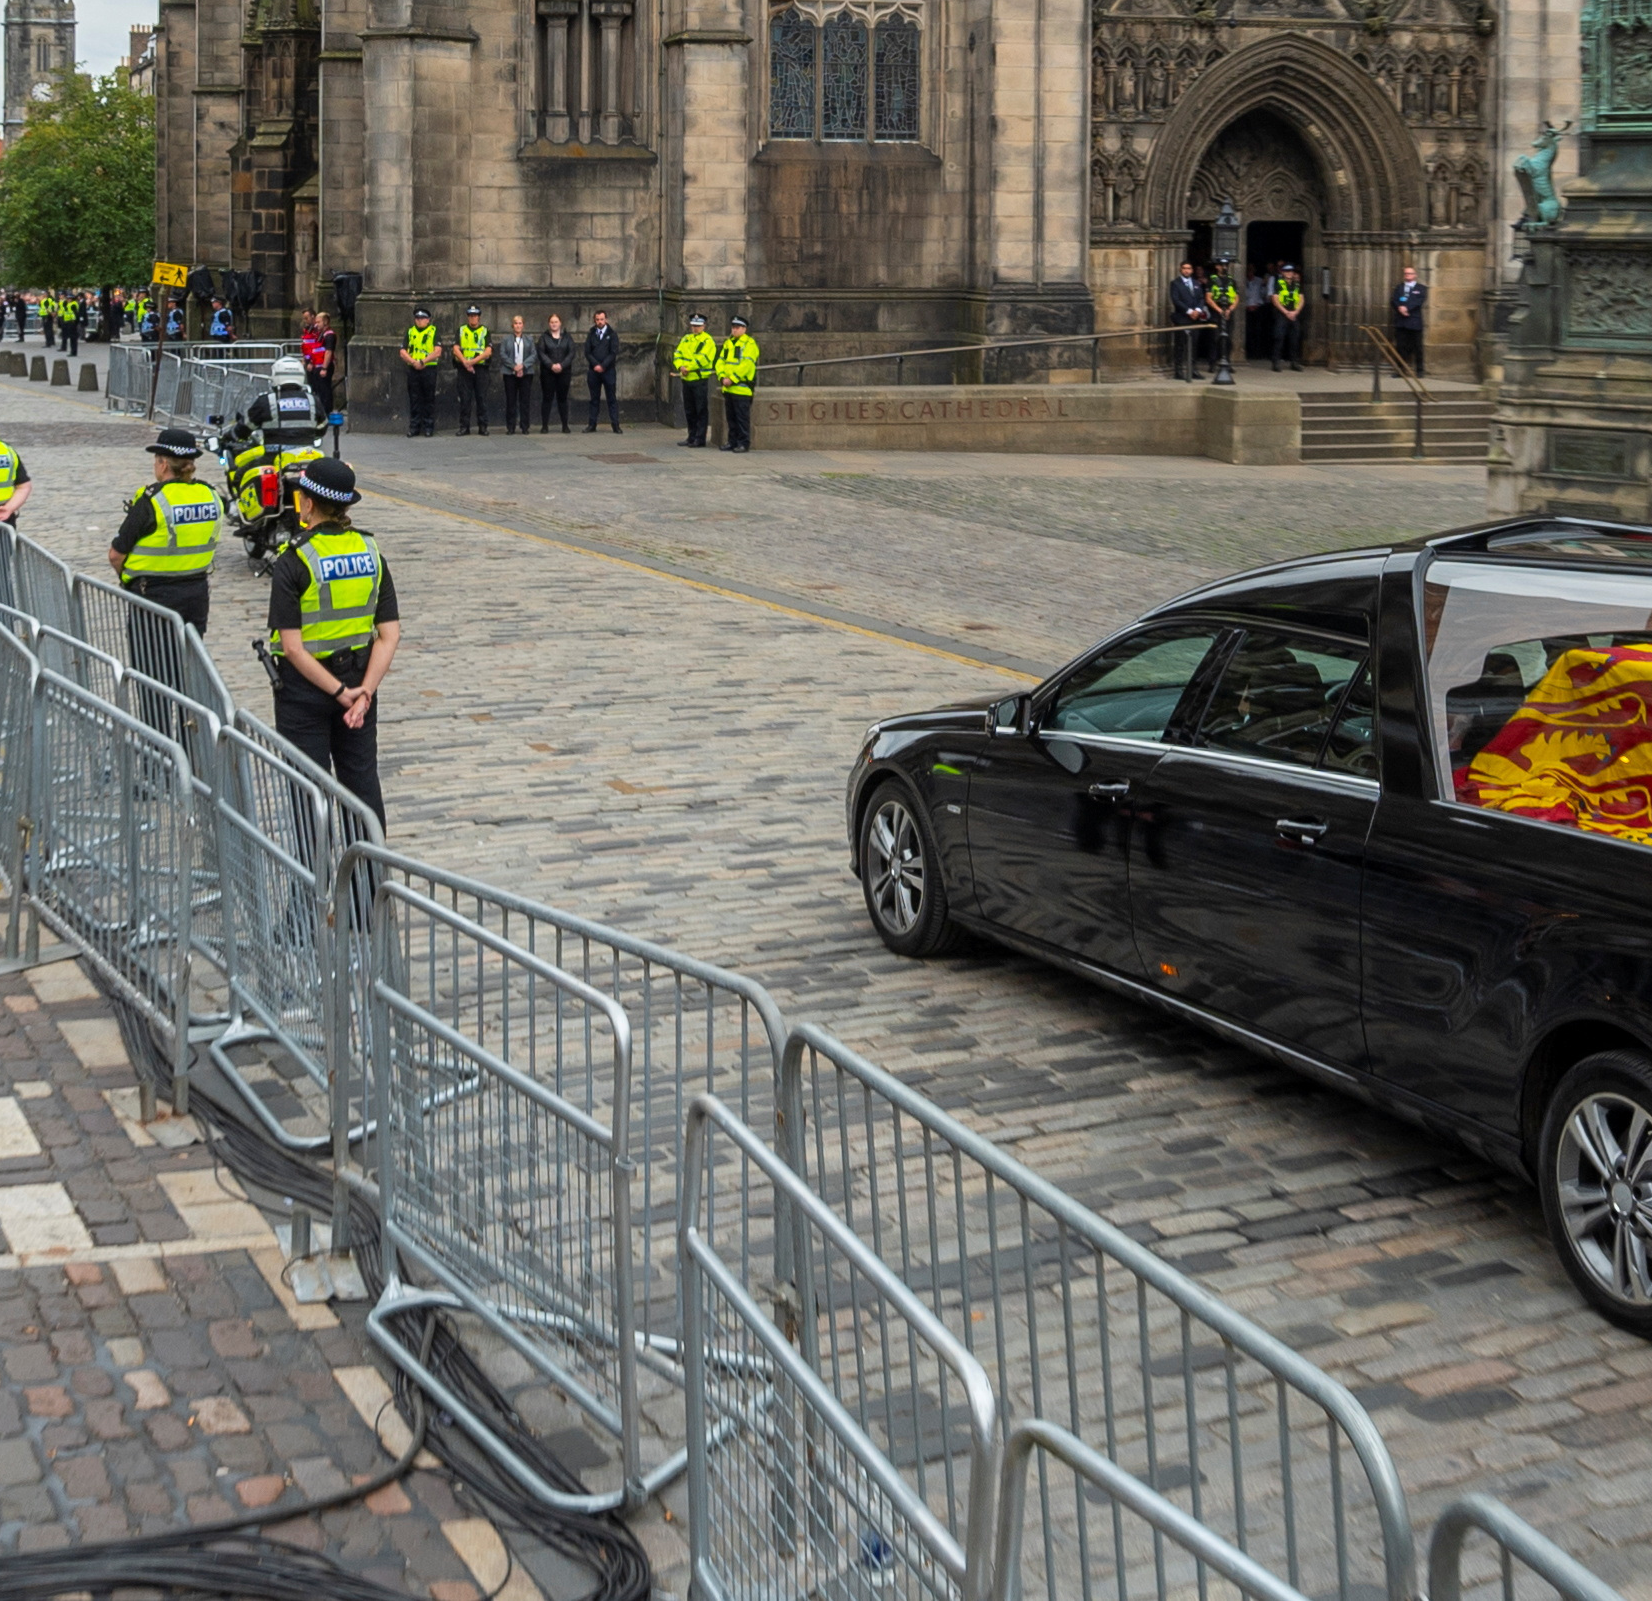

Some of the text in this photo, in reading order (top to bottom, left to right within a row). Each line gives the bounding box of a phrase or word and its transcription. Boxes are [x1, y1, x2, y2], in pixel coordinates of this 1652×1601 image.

[279, 398, 310, 410] POLICE
[768, 402, 798, 420] ST
[899, 400, 1069, 420] CATHEDRAL
[174, 504, 217, 523] POLICE
[322, 555, 375, 578] POLICE
